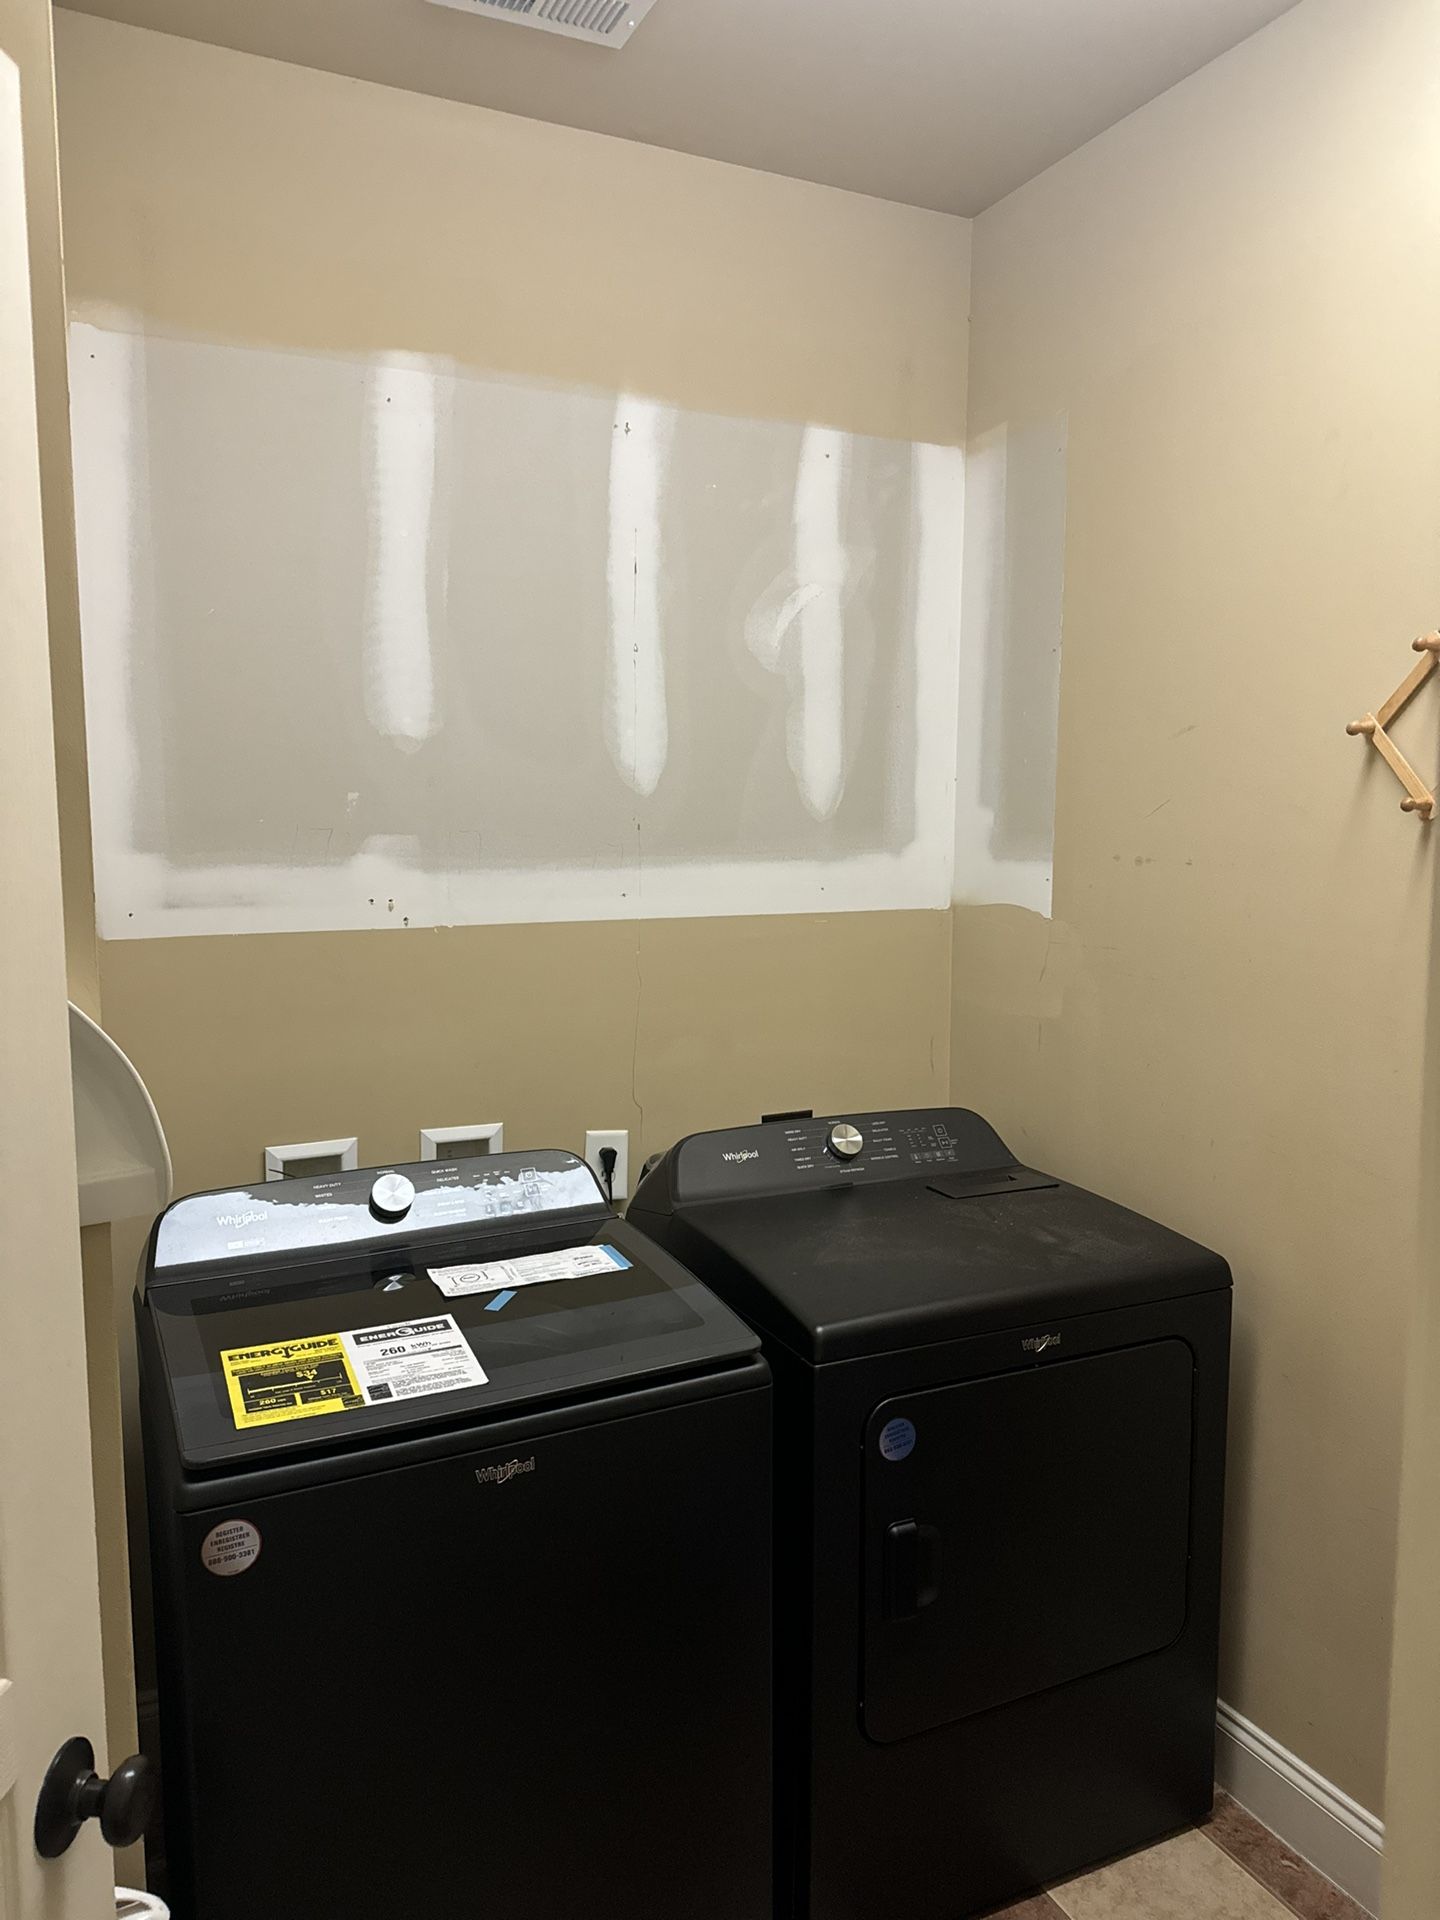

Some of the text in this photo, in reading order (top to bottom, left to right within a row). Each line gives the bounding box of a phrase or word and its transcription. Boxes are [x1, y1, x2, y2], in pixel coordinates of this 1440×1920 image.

[722, 1149, 759, 1163] Whirlpool
[216, 1210, 268, 1229] Whirlpool
[228, 1338, 340, 1361] ENERGYGUIDE
[380, 1341, 432, 1356] 260 kWh
[1021, 1333, 1061, 1353] Whirlpool
[259, 1398, 276, 1406] 260
[475, 1456, 536, 1484] Whirlpool
[215, 1526, 244, 1538] REGISTER
